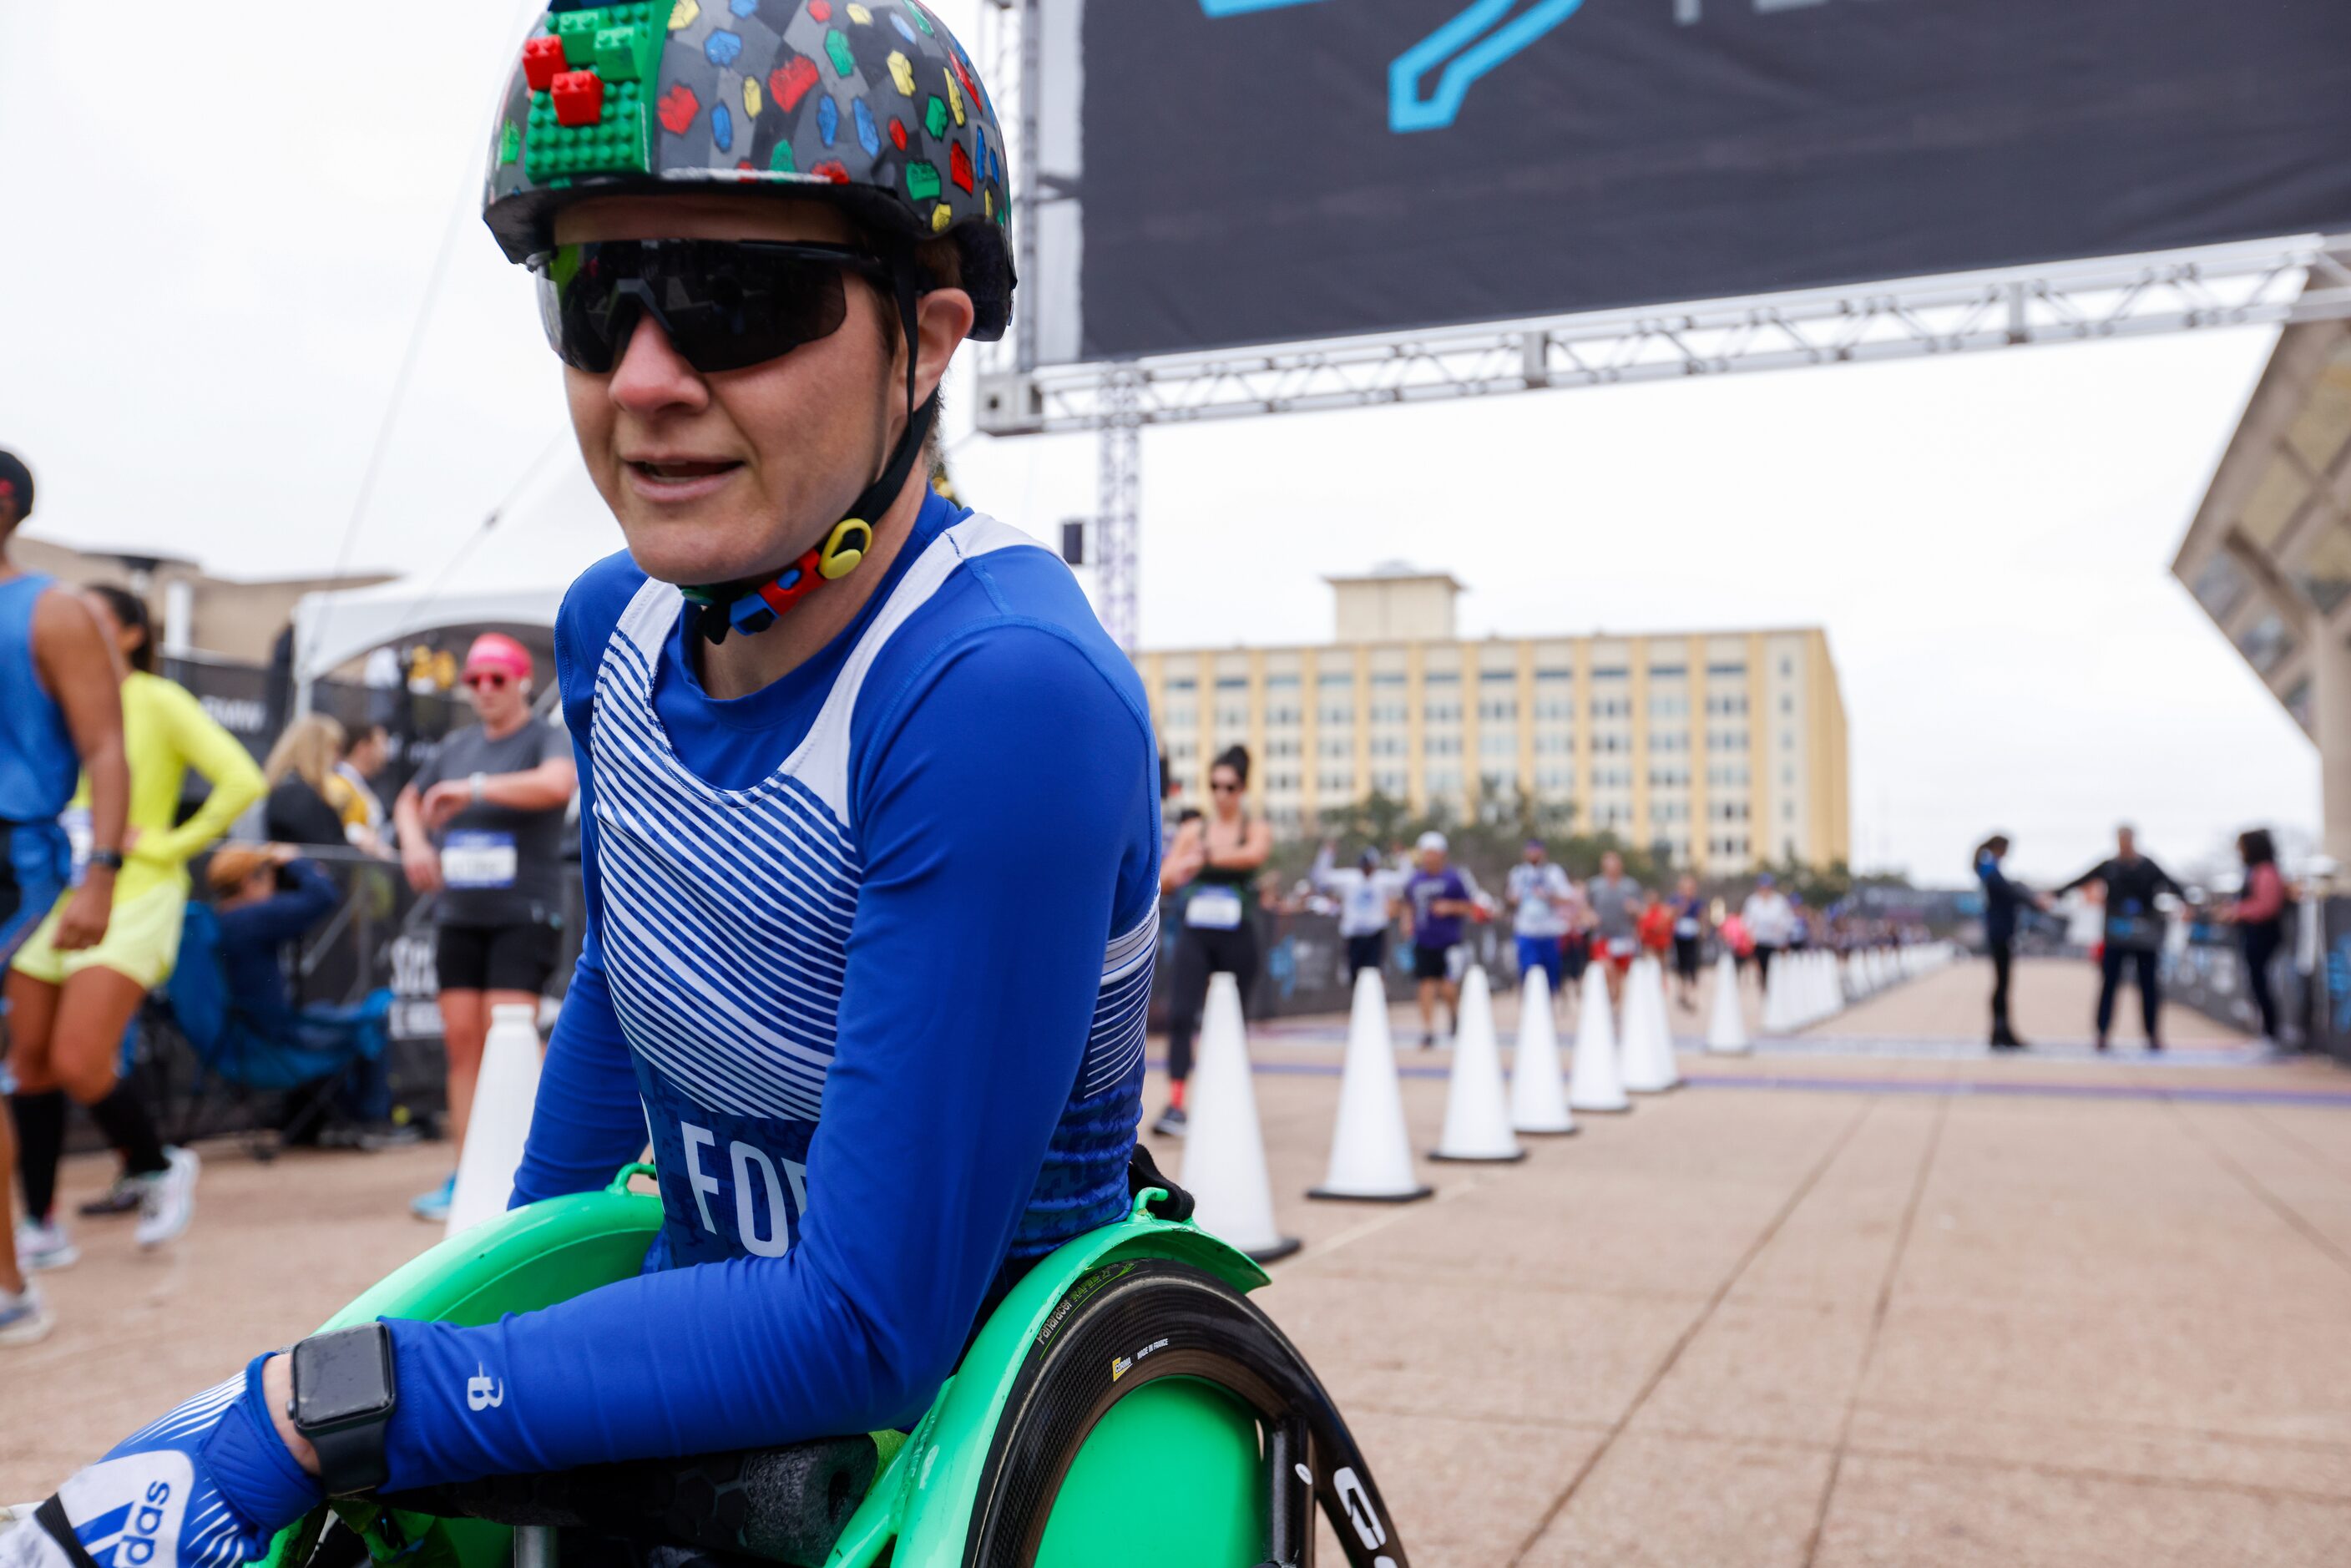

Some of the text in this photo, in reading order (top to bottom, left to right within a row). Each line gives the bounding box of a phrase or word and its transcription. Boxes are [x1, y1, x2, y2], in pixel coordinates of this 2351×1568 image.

[1137, 1338, 1169, 1360] MADE IN FRANCE
